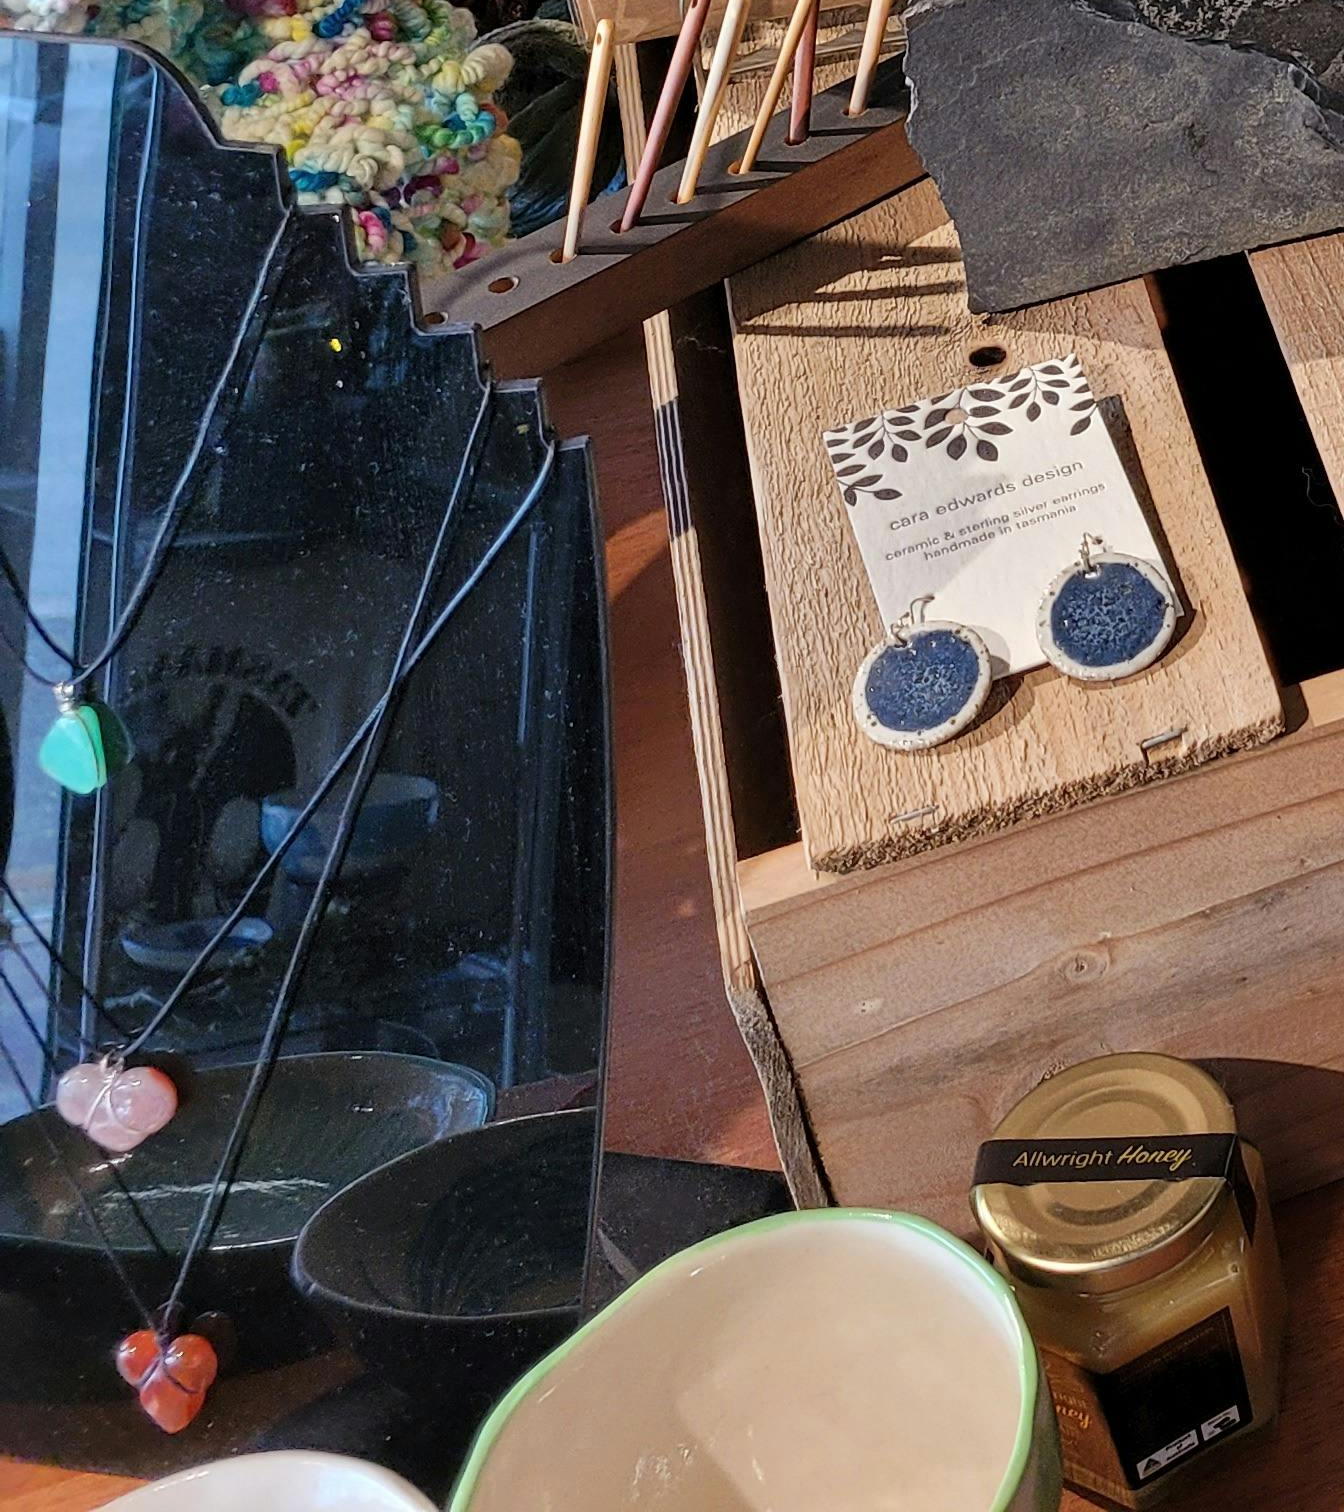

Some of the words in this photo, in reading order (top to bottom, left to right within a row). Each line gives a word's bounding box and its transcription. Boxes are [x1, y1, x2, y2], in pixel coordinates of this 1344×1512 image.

[885, 537, 940, 561] ceramic
[943, 531, 956, 542] &
[959, 514, 1010, 536] sterling
[1012, 501, 1048, 519] silver
[1052, 483, 1106, 505] earrings
[889, 511, 930, 531] cara
[935, 482, 1017, 516] edwards
[1022, 462, 1084, 487] design
[924, 531, 996, 561] handmade
[997, 525, 1013, 536] in
[1015, 504, 1077, 530] tasmania
[1012, 1149, 1116, 1169] Allwright
[1116, 1145, 1194, 1171] Honey
